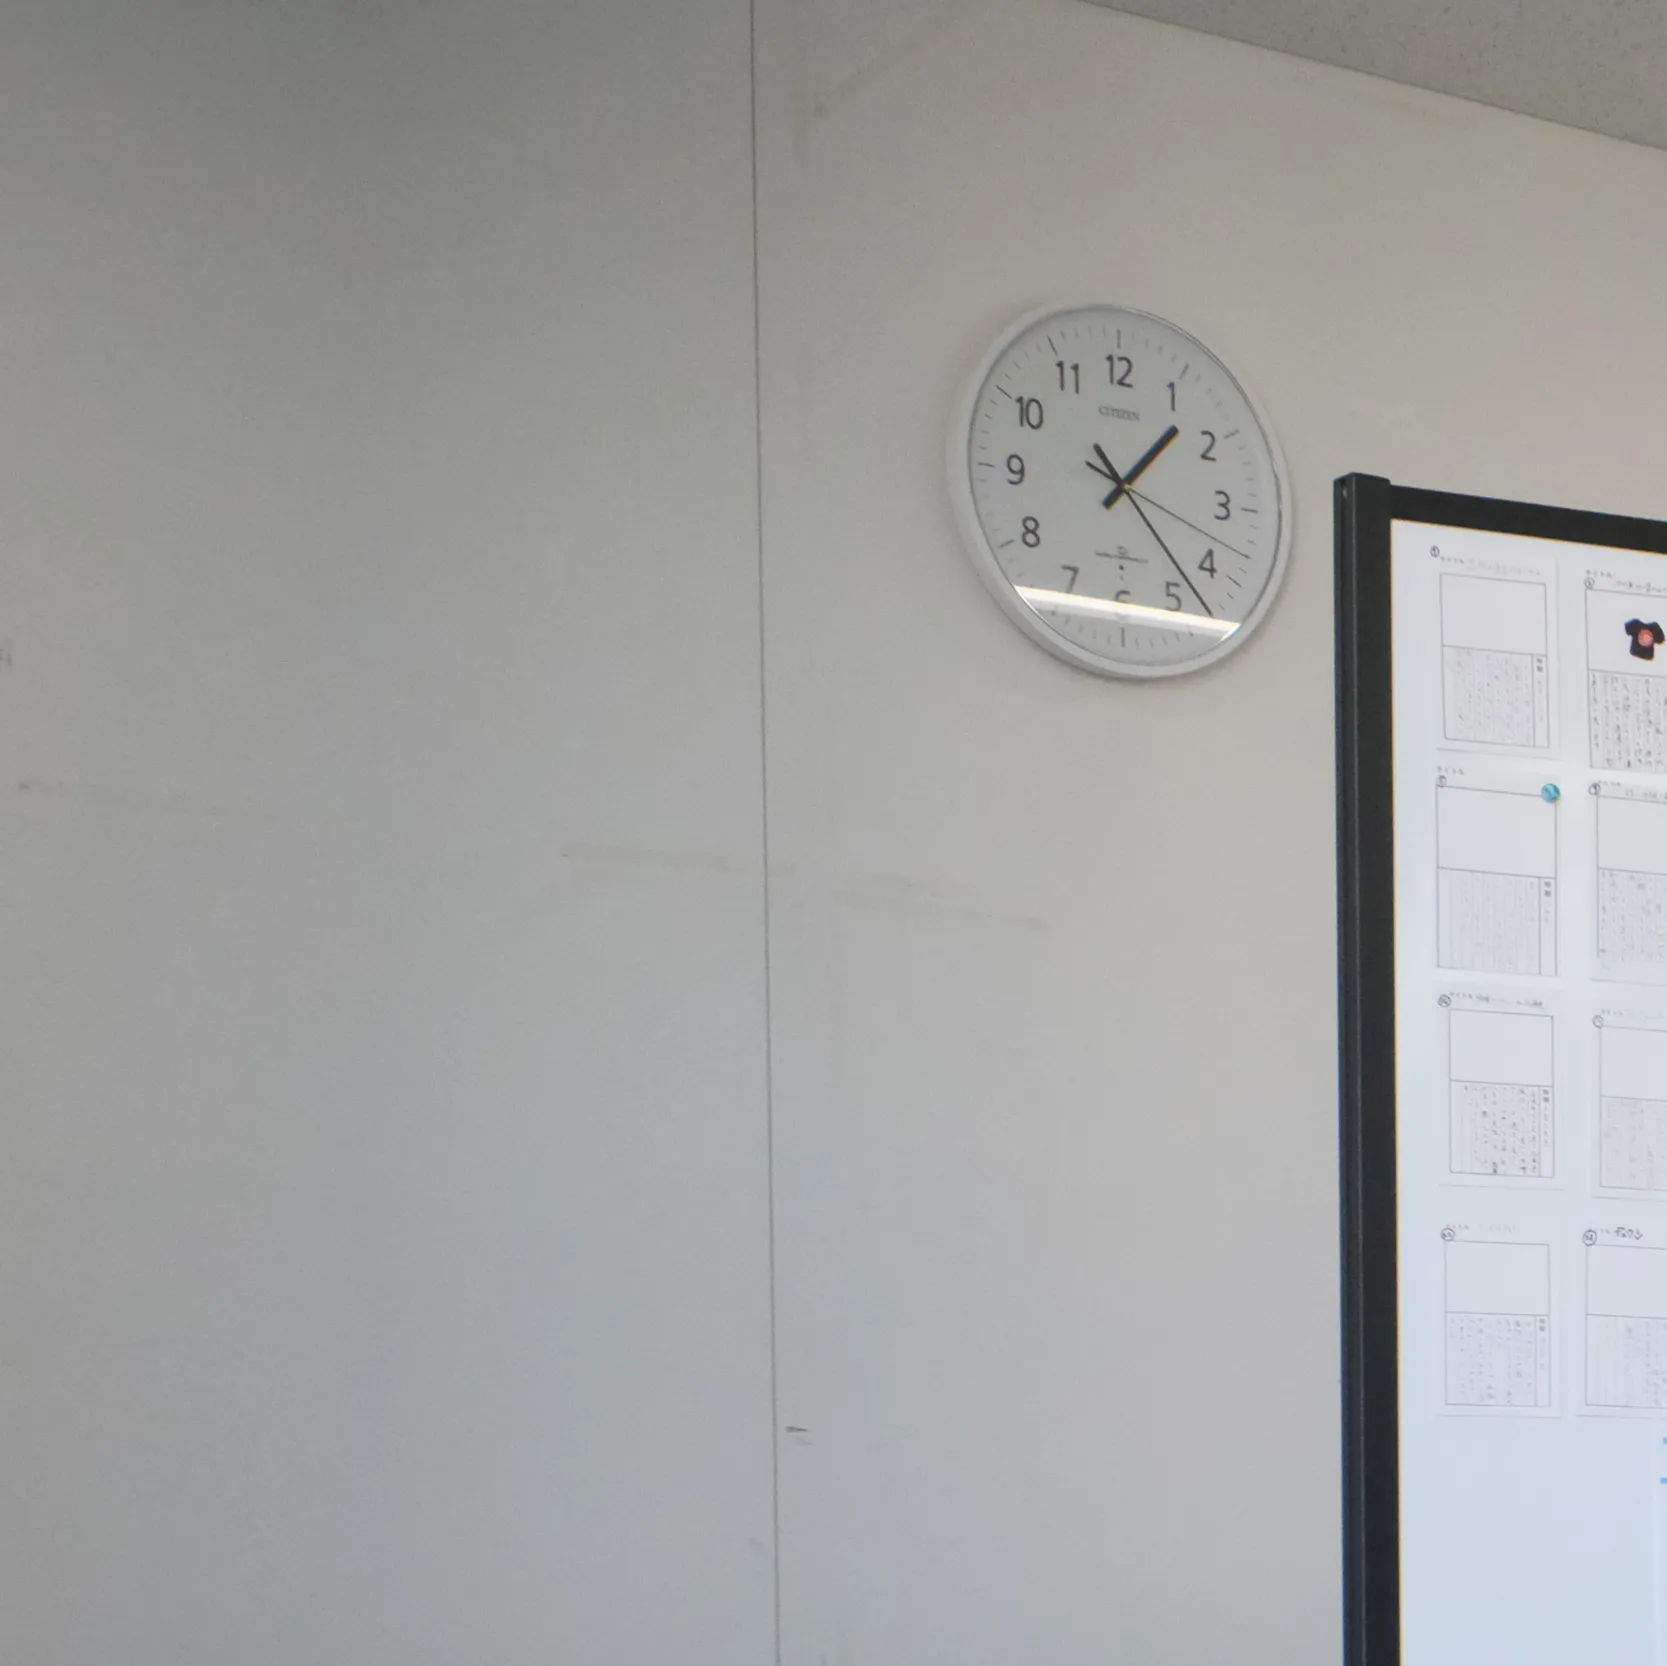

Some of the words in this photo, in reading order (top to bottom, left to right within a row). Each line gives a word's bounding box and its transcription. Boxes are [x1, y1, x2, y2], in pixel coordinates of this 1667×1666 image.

[1056, 361, 1080, 394] 11
[1106, 354, 1134, 388] 12
[1167, 382, 1176, 411] 1
[1016, 397, 1043, 430] 10
[1200, 431, 1216, 462] 2
[1006, 454, 1025, 485] 9
[1214, 491, 1231, 521] 3
[1022, 517, 1040, 548] 8
[1061, 565, 1079, 593] 7
[1198, 549, 1217, 578] 4
[1165, 583, 1182, 612] 5
